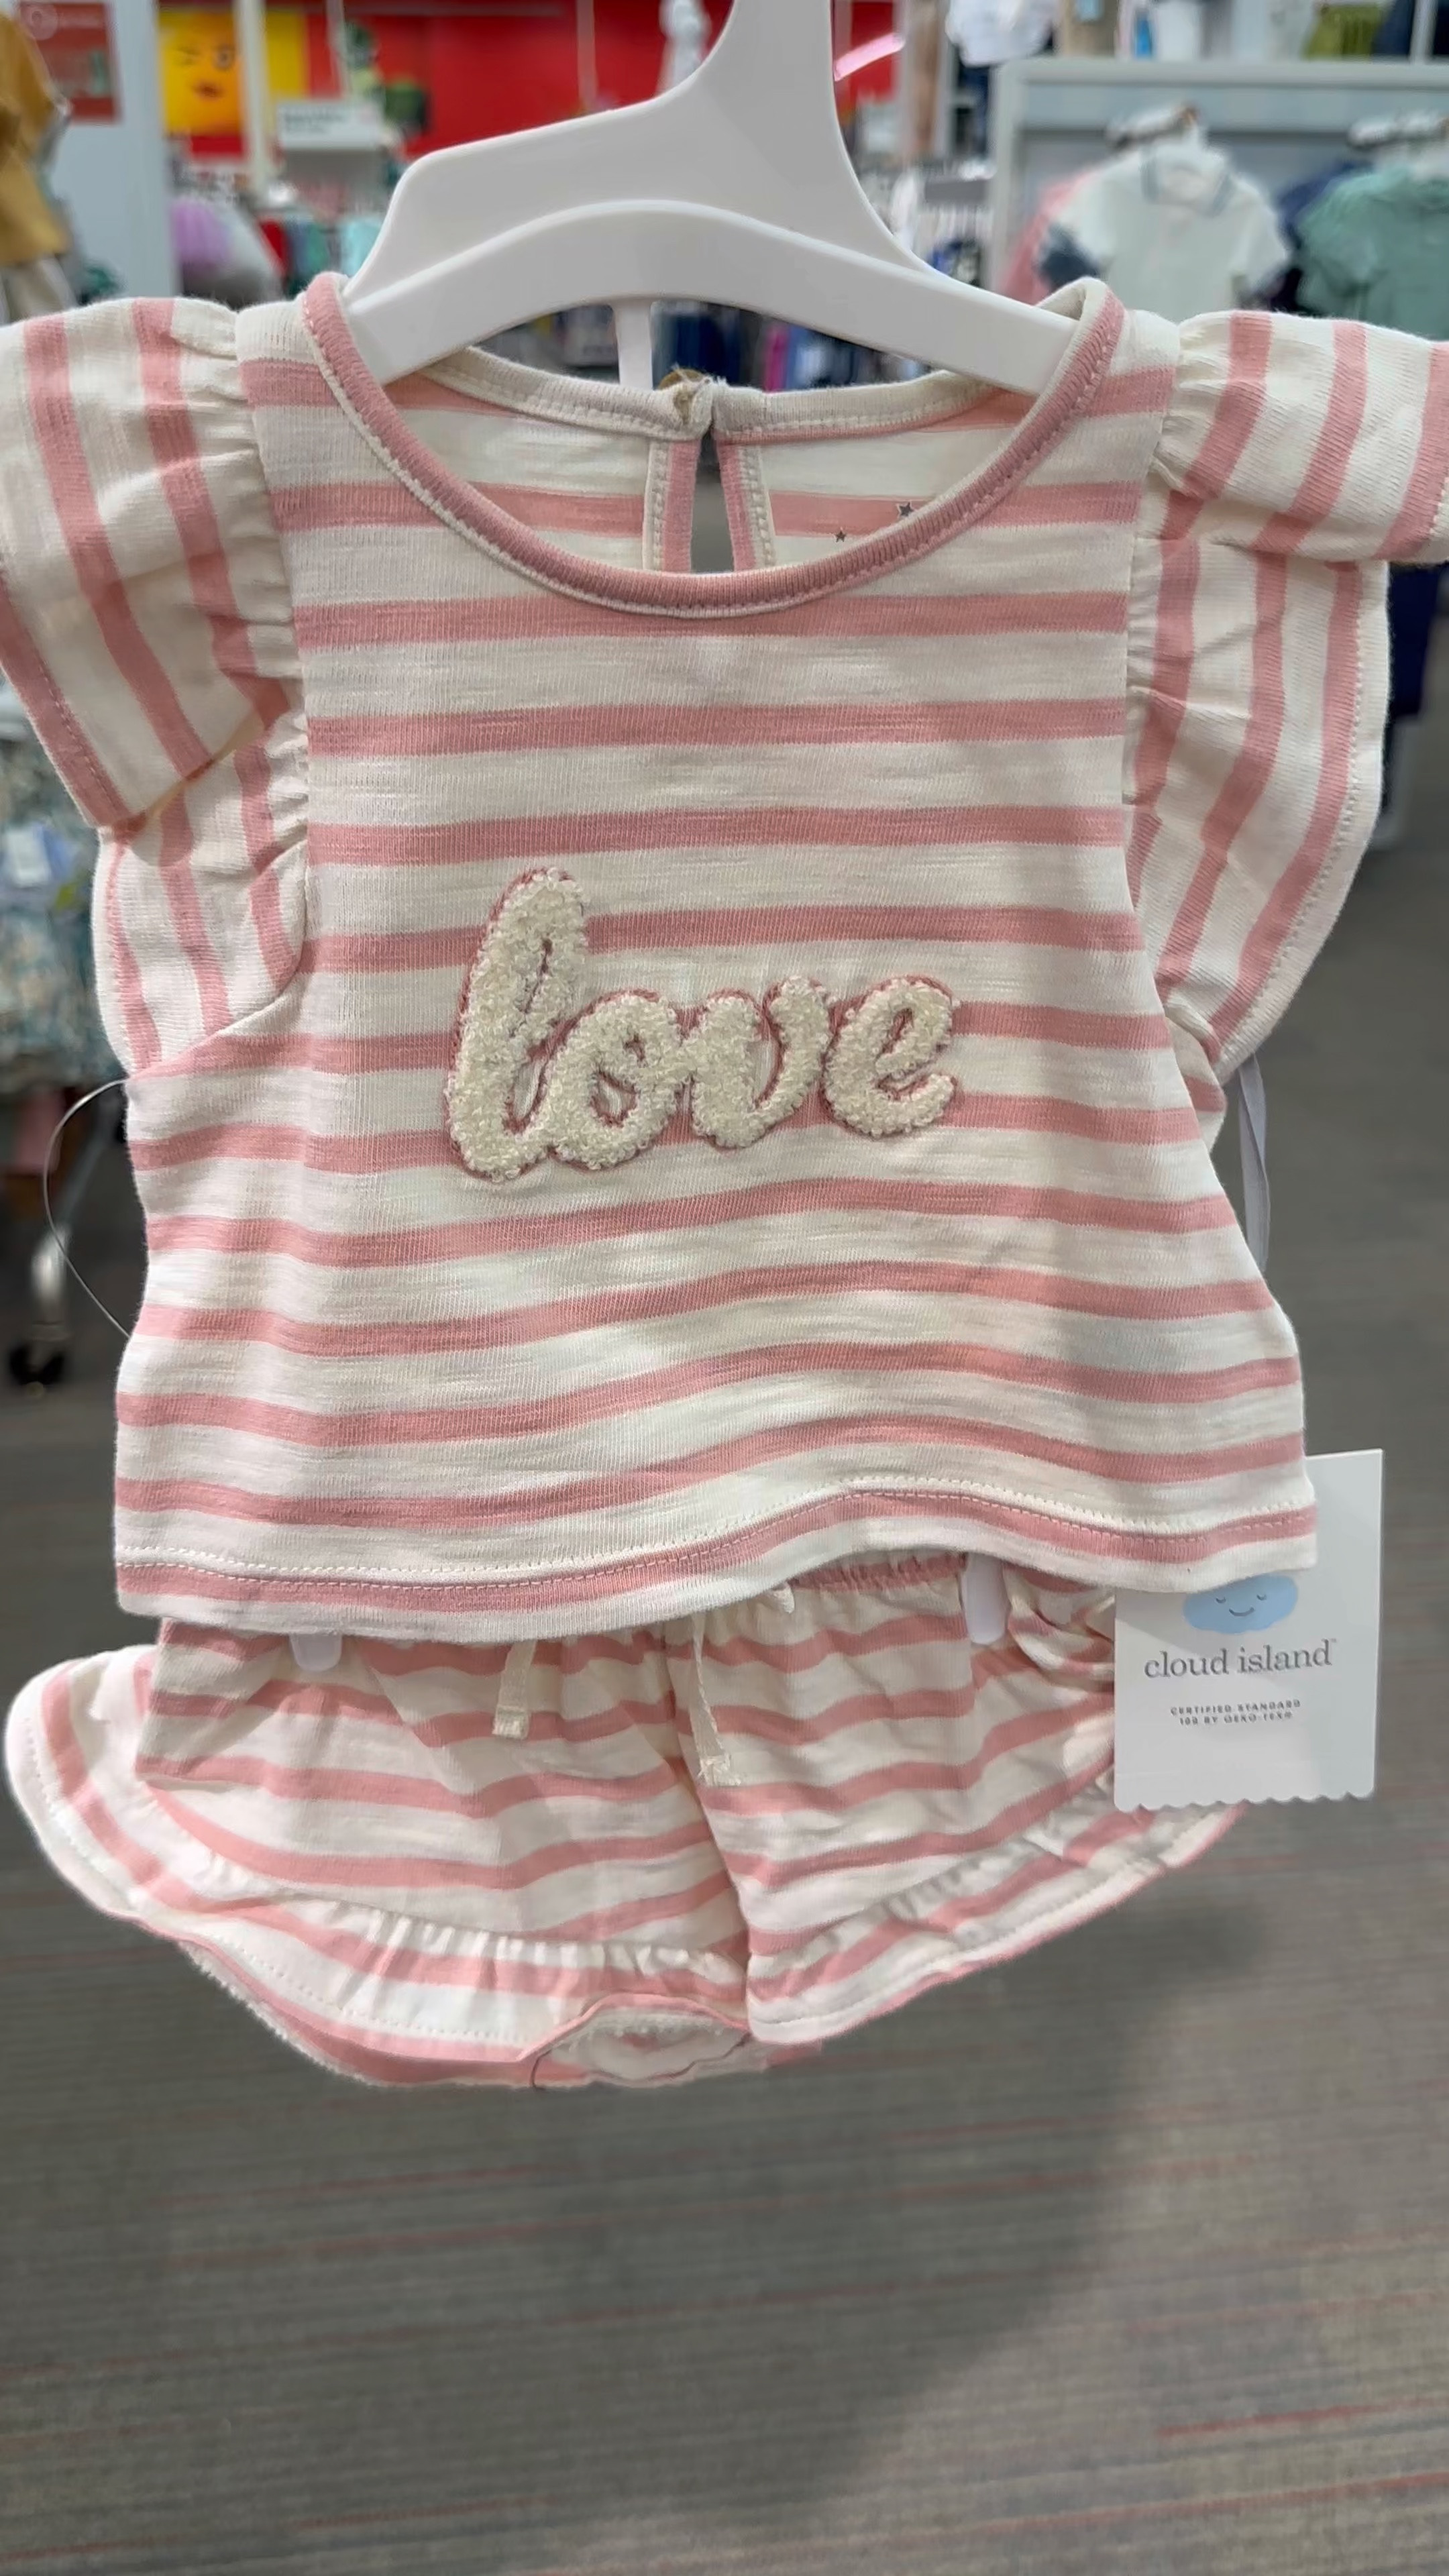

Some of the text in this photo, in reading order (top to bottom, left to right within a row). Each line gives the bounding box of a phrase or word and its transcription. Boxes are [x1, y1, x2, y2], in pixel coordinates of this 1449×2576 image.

[445, 866, 960, 1182] love
[1144, 1648, 1230, 1678] cloud
[1237, 1699, 1301, 1712] STANDARD
